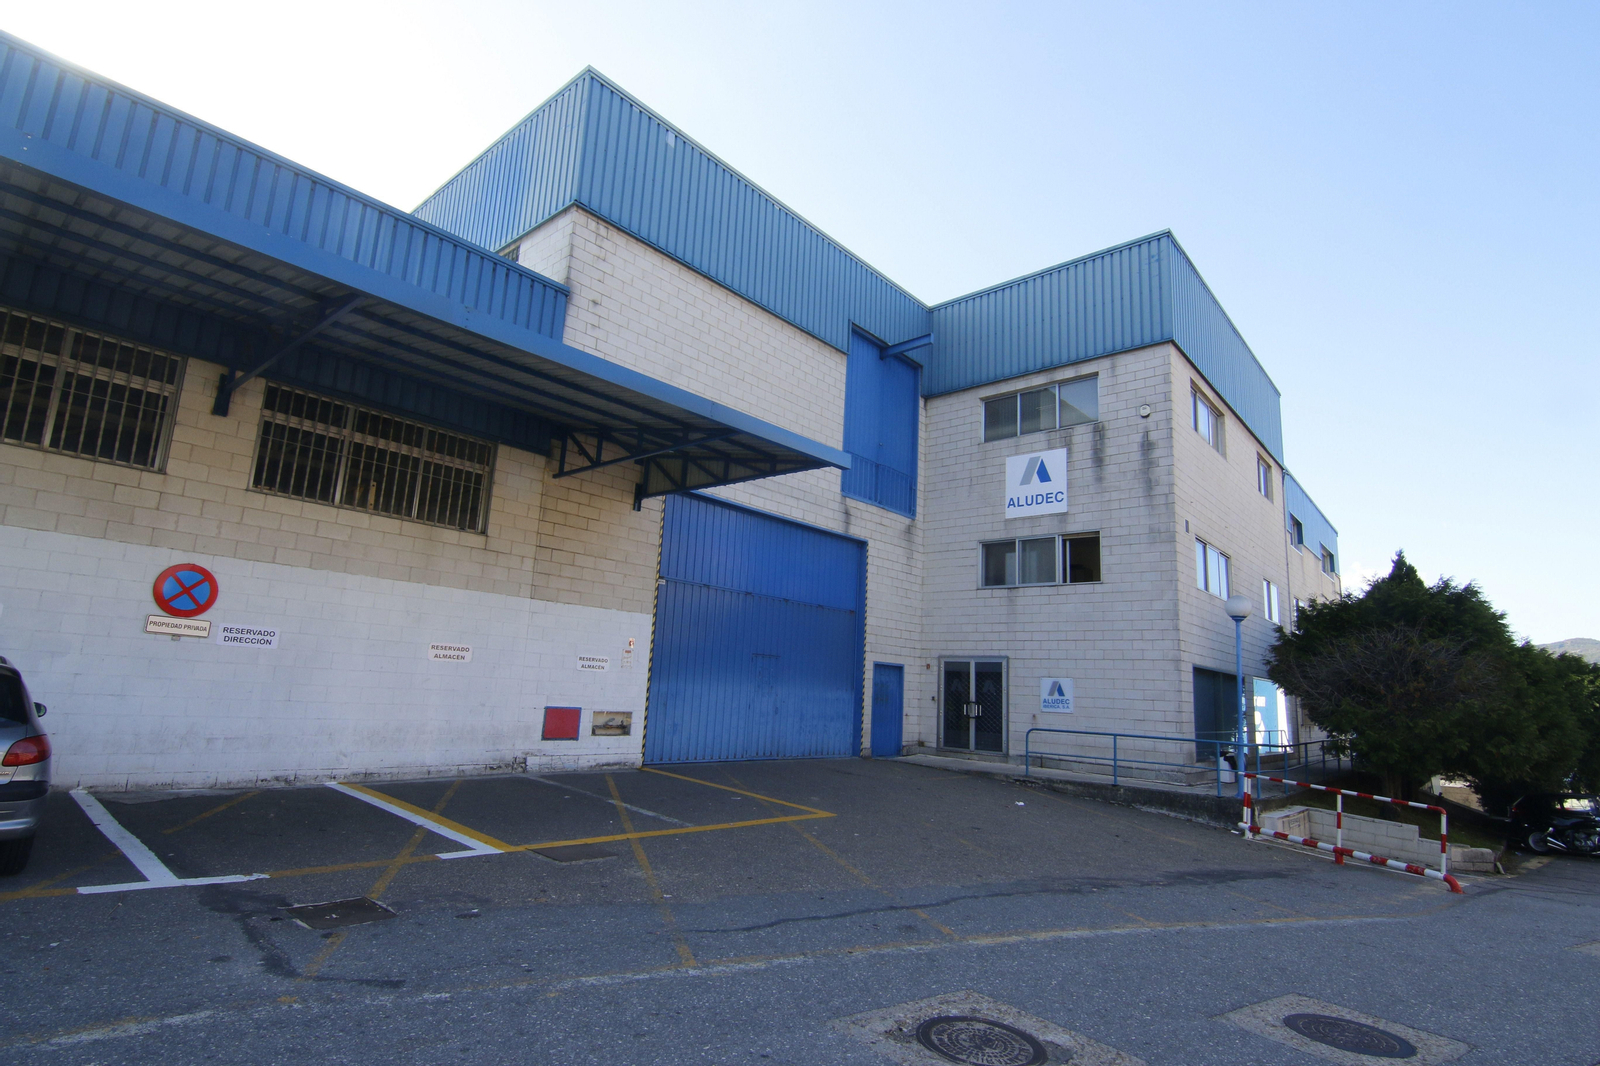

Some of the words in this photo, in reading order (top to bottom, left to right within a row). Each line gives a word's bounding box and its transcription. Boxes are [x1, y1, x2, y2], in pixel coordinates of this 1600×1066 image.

[1007, 491, 1064, 508] ALUDEC
[149, 620, 182, 630] PROPIEDAD
[222, 626, 276, 637] RESERVADO
